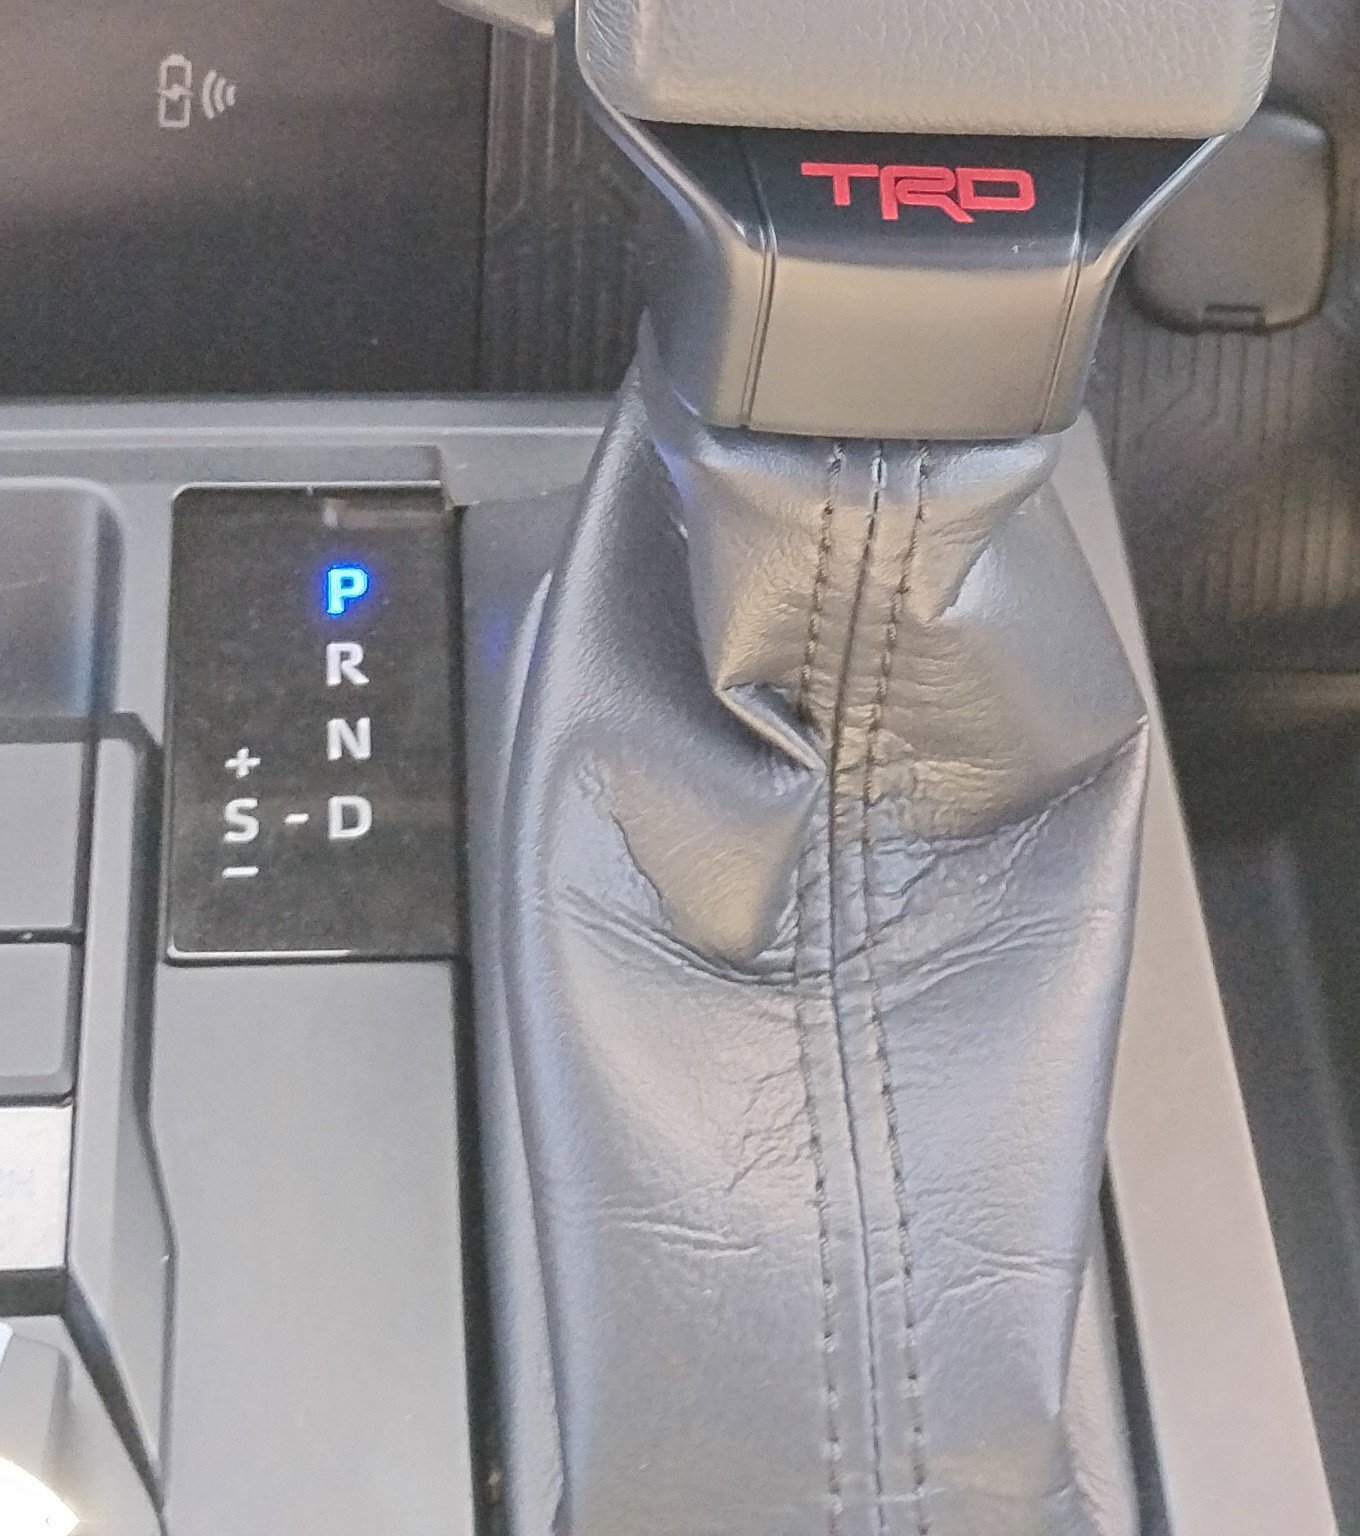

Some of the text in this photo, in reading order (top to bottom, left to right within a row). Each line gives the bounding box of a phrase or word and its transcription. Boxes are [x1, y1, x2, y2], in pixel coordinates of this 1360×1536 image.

[800, 159, 1036, 224] TRD
[327, 566, 369, 615] P
[326, 640, 370, 687] R
[326, 715, 371, 762] N
[223, 797, 260, 843] S
[328, 795, 372, 842] D
